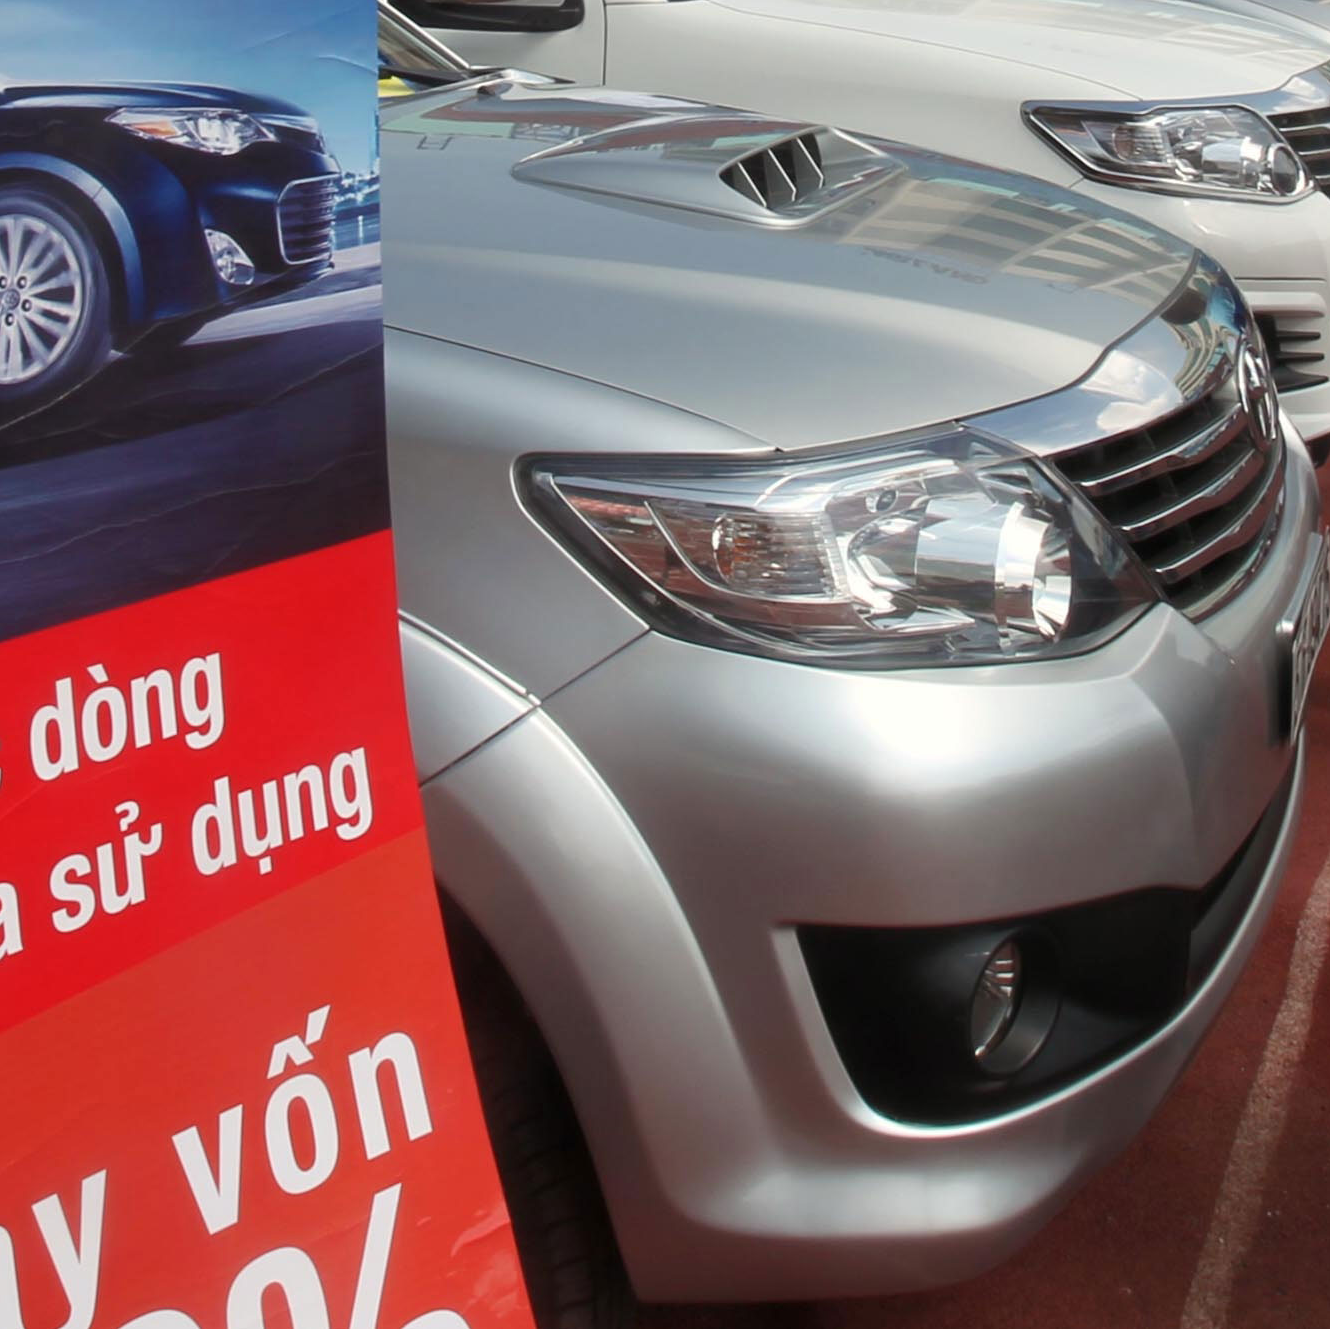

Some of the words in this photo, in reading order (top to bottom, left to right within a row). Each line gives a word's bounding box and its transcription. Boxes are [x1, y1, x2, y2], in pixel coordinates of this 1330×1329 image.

[29, 652, 227, 781] dòng
[49, 801, 163, 933] sử
[191, 747, 374, 876] dụng
[171, 1004, 434, 1236] vốn
